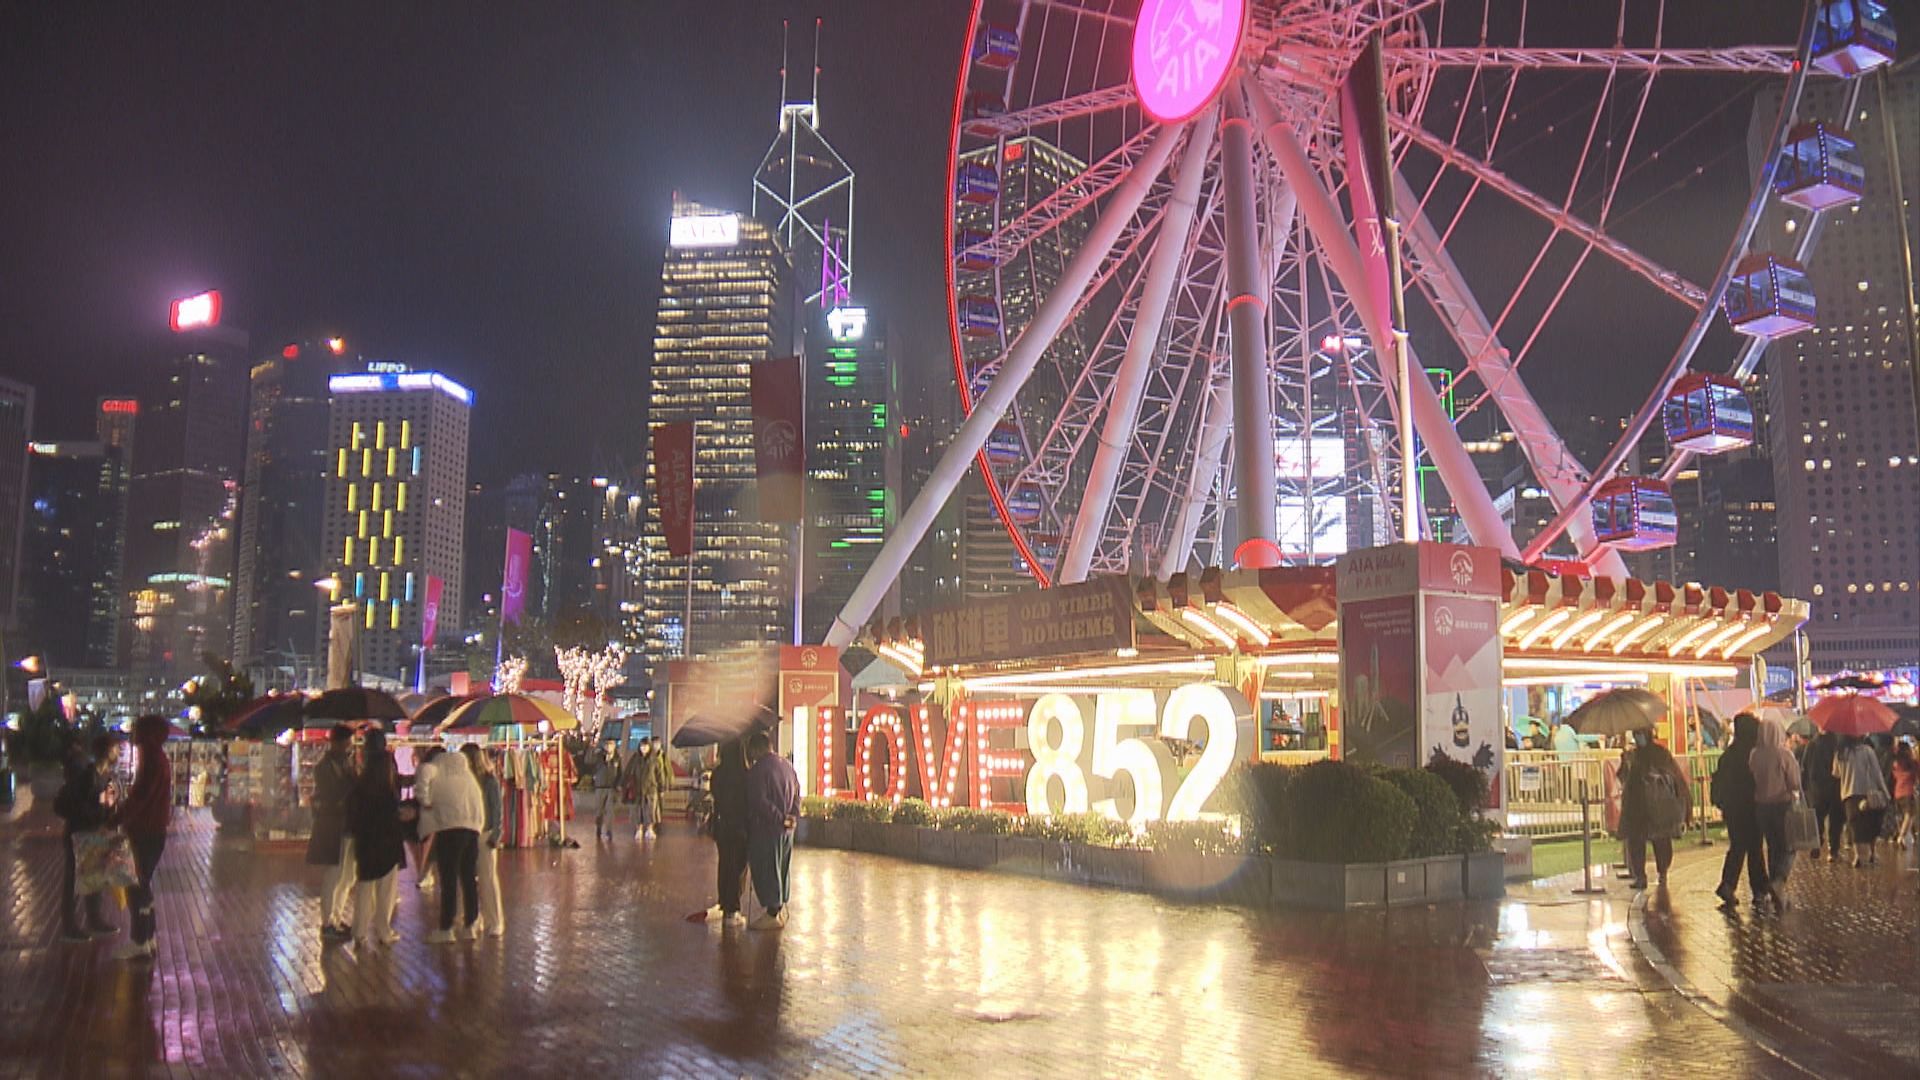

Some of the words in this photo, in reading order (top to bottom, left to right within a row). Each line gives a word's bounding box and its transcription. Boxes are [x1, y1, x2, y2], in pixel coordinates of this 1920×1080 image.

[1155, 40, 1220, 98] AIA
[367, 361, 407, 373] LIPPO
[1348, 557, 1374, 575] AIA
[1356, 574, 1393, 591] PARK
[1020, 602, 1050, 621] OLD
[1059, 593, 1113, 616] TIMER
[1021, 615, 1116, 645] DODGEMS
[817, 699, 1028, 815] LOVE
[1025, 683, 1240, 821] 852
